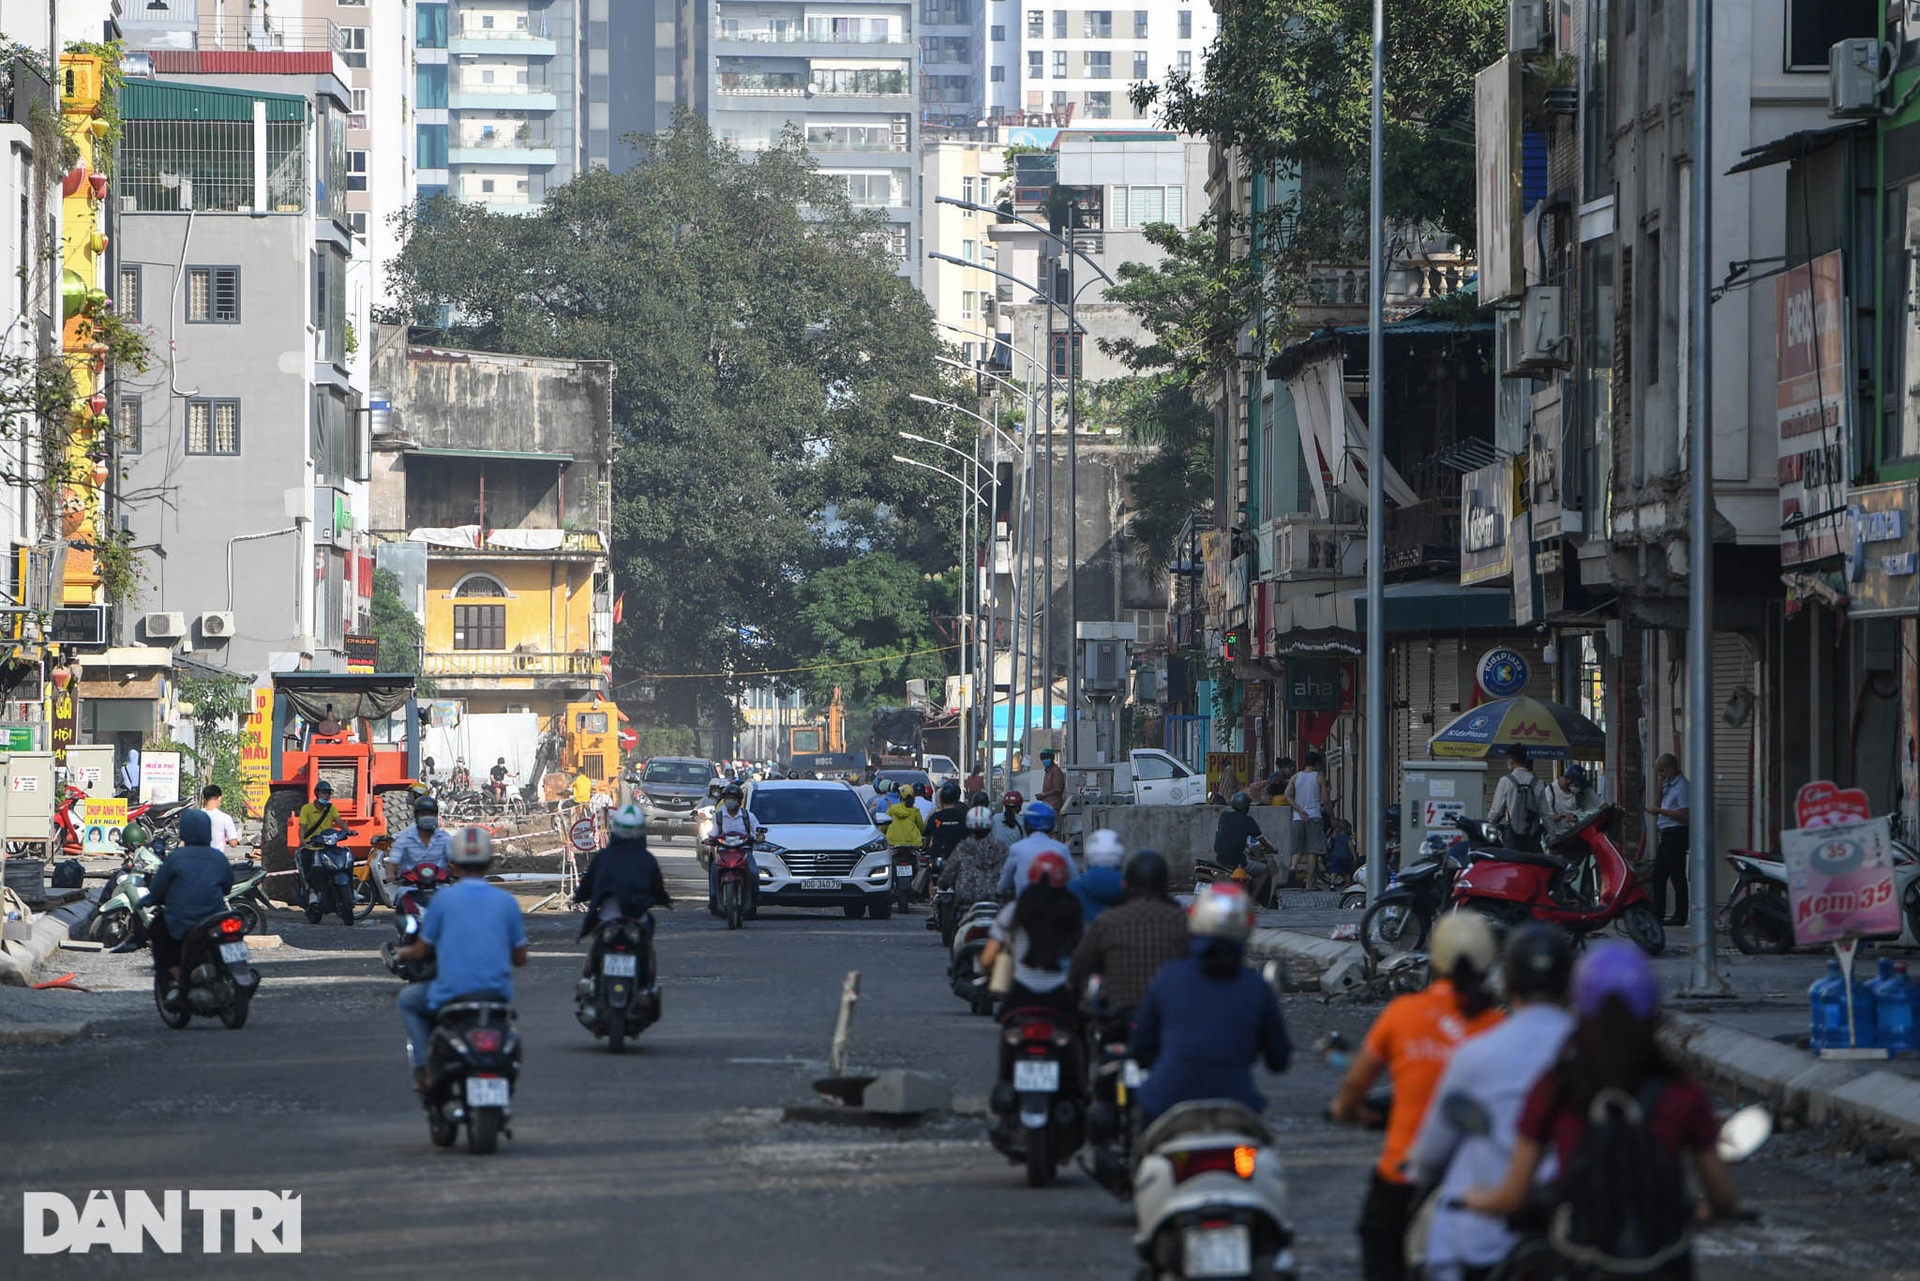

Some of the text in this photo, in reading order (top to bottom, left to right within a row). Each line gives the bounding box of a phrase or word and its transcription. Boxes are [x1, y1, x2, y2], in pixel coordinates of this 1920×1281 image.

[1485, 651, 1523, 673] KidsPlaza
[1294, 674, 1333, 696] aha
[53, 727, 72, 742] HỘI
[1447, 729, 1489, 739] KidsPlaza
[1209, 755, 1246, 773] PHTO
[1826, 843, 1847, 859] 35
[1798, 879, 1893, 924] Kem 35
